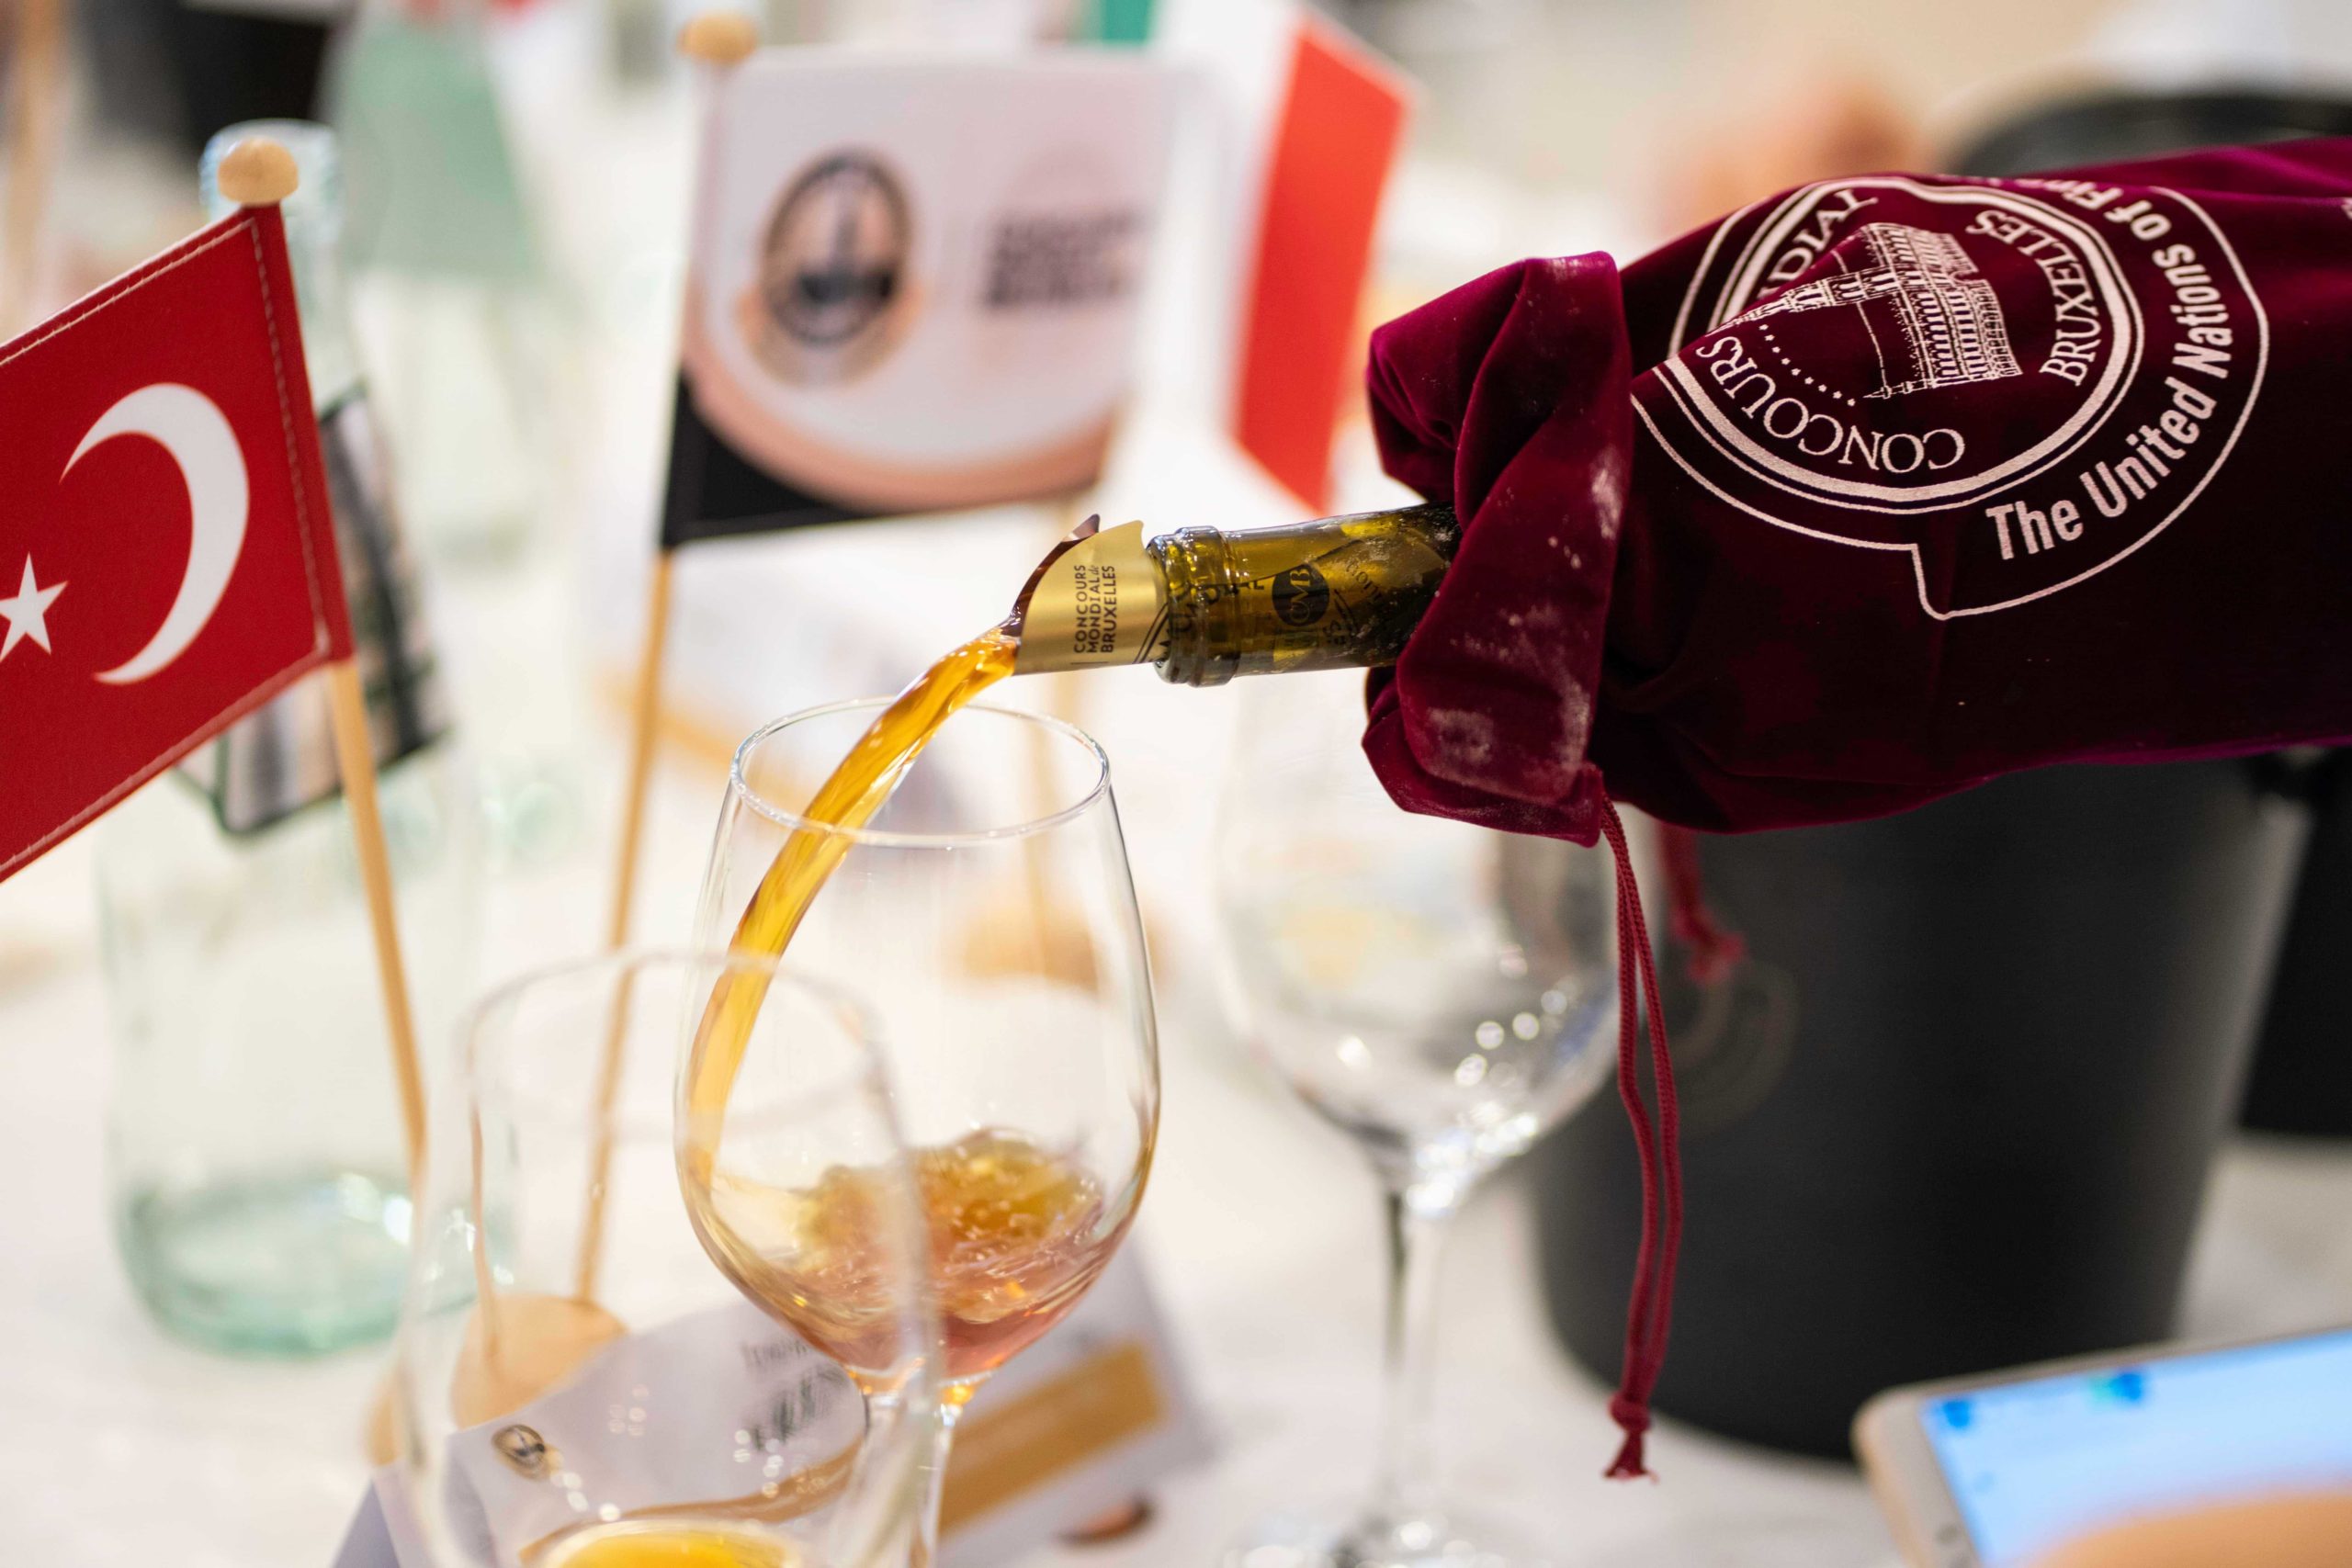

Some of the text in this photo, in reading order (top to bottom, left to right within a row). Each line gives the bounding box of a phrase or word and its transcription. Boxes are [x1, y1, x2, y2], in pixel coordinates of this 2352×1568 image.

[2104, 200, 2171, 241] of
[1695, 188, 2101, 474] CONCOURS DIAL BRUXELLES
[2152, 243, 2233, 379] Nations
[2079, 376, 2217, 518] United
[1984, 500, 2083, 560] The
[1073, 564, 1088, 653] CONCOURS
[1086, 578, 1102, 653] MONDIAL
[1101, 565, 1117, 653] BRUXELLES
